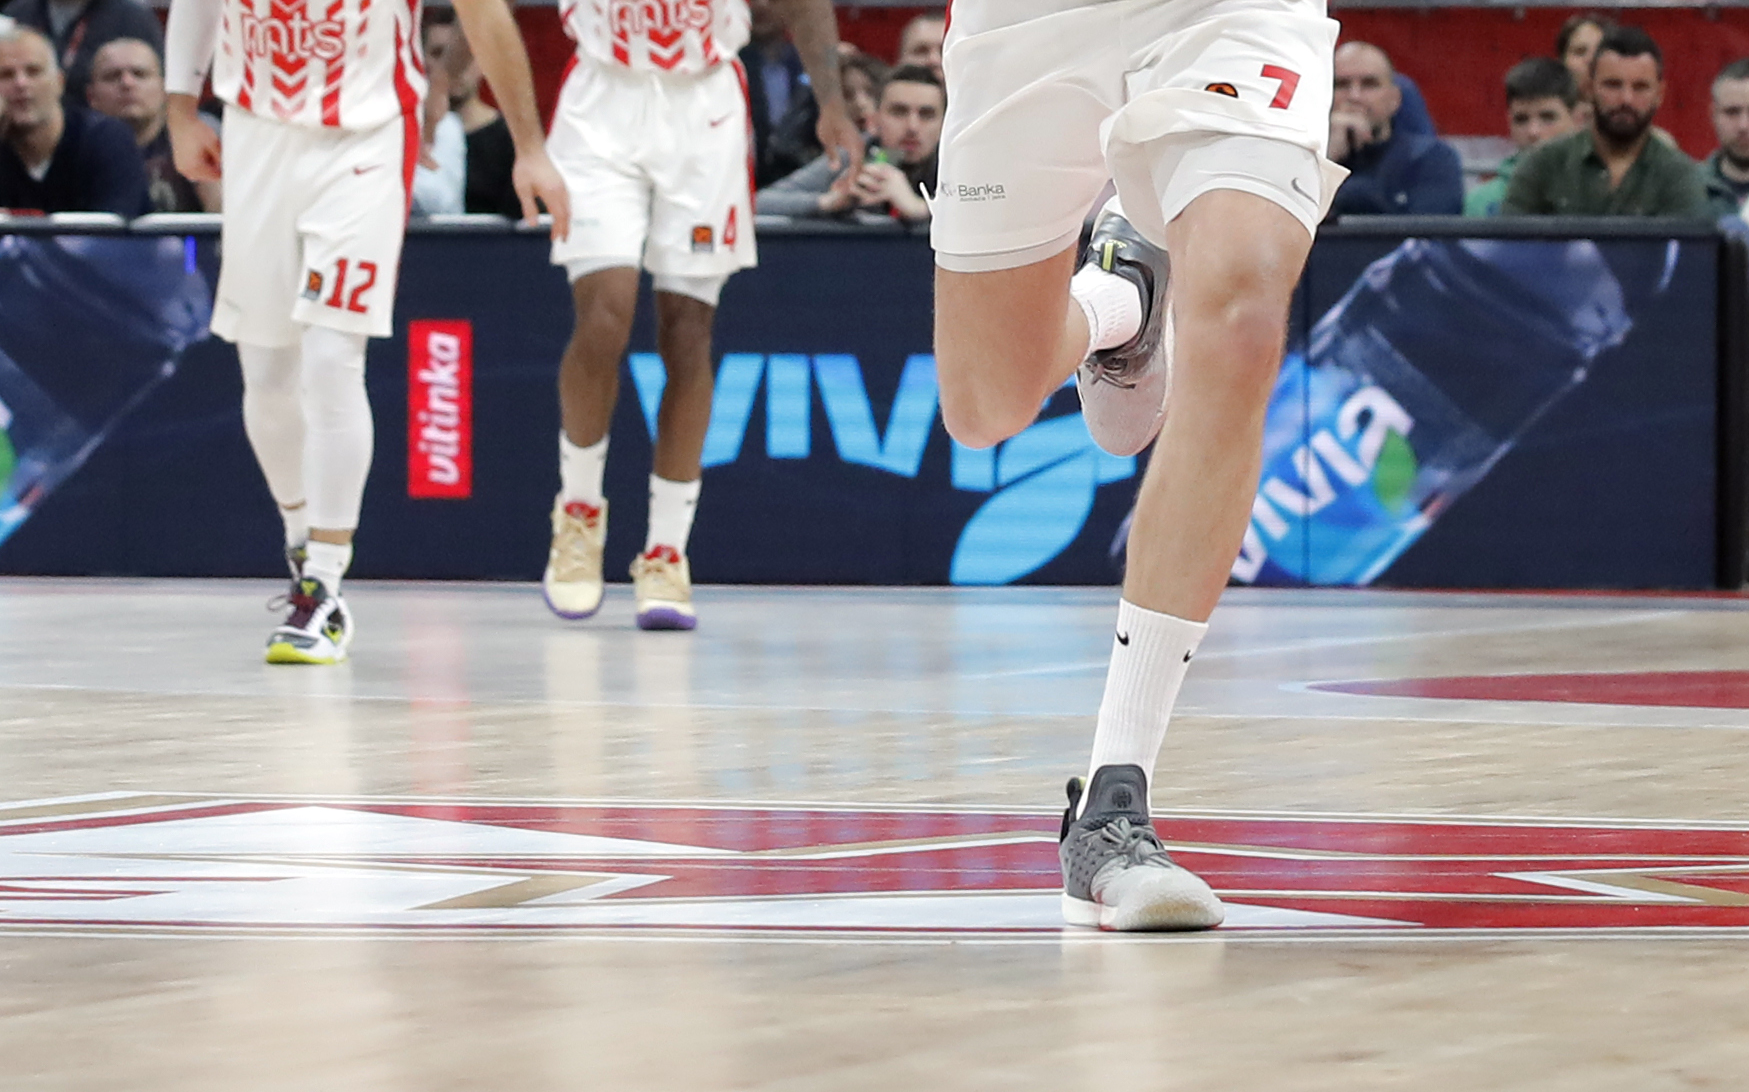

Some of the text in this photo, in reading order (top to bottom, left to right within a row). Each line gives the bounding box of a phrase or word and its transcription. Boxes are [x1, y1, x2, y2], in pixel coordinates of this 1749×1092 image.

[242, 14, 345, 60] mts
[1260, 63, 1301, 110] 7
[958, 184, 1005, 197] Banka
[324, 258, 377, 314] 12
